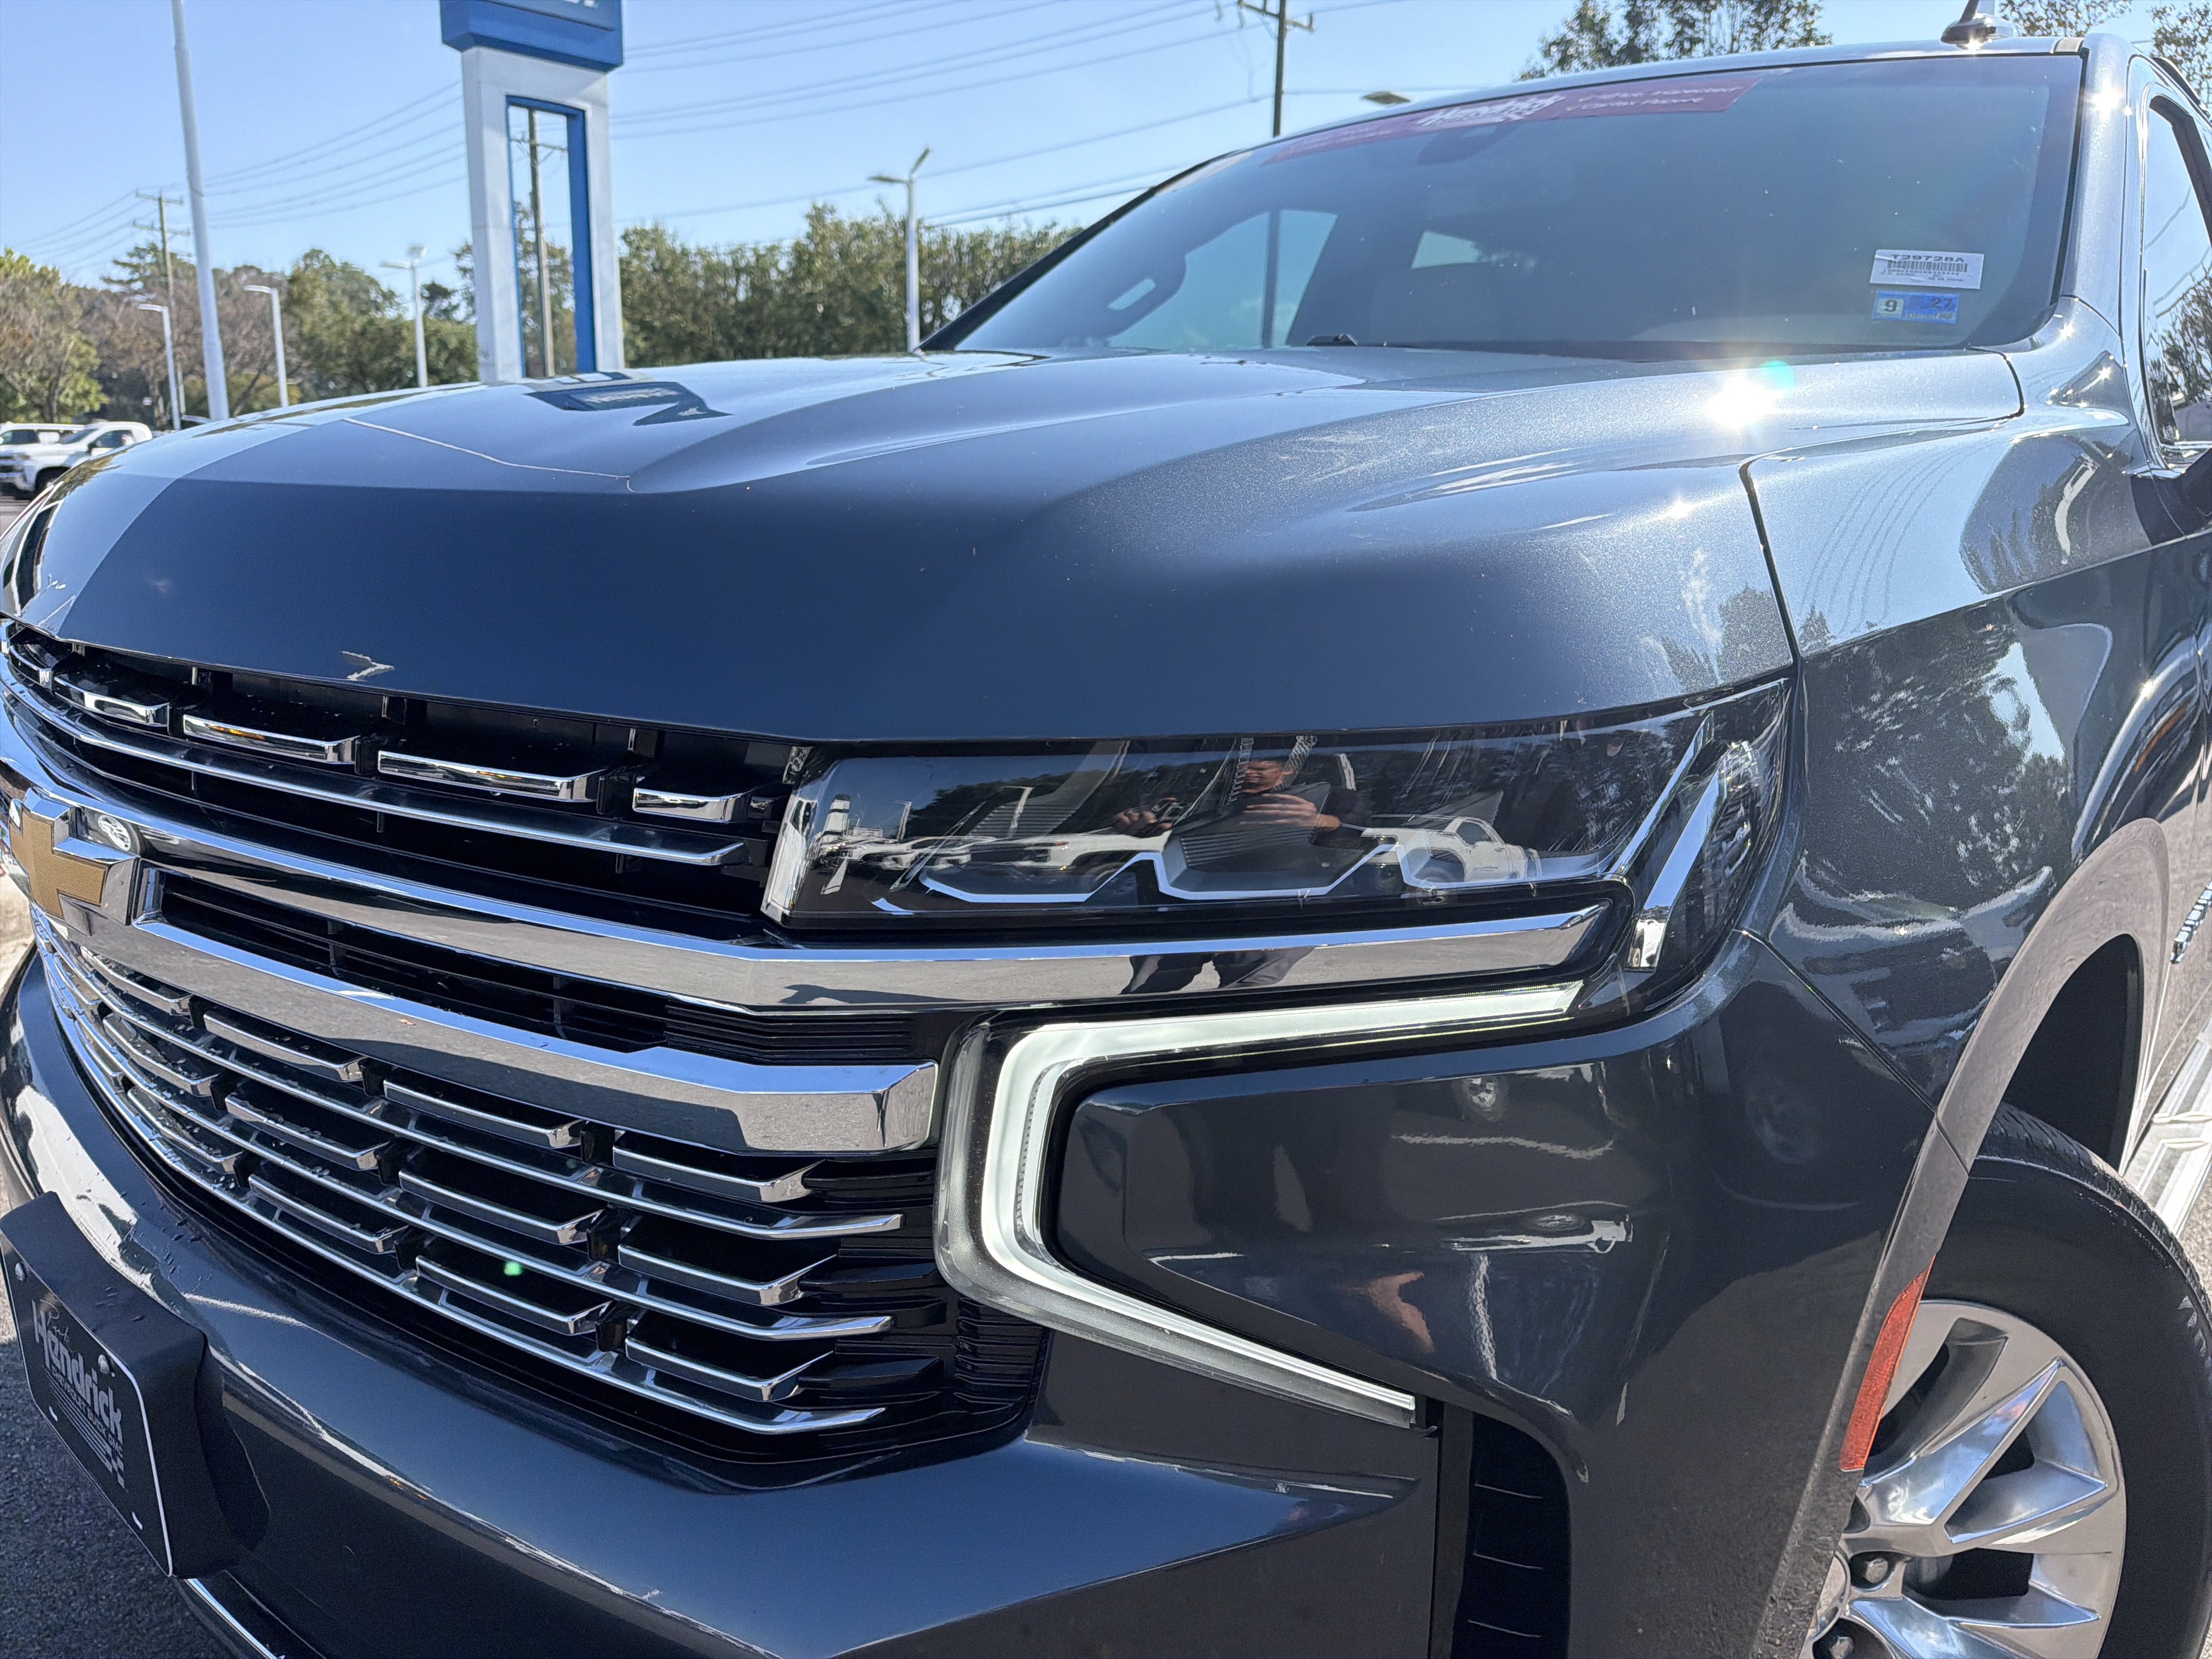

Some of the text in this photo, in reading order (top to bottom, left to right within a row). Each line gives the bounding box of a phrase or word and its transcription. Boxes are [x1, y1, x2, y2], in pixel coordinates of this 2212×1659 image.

[1884, 297, 1954, 312] 9 27
[32, 1299, 123, 1444] Hendrick
[51, 1364, 123, 1459] CHEVROLET BUICK GMC
